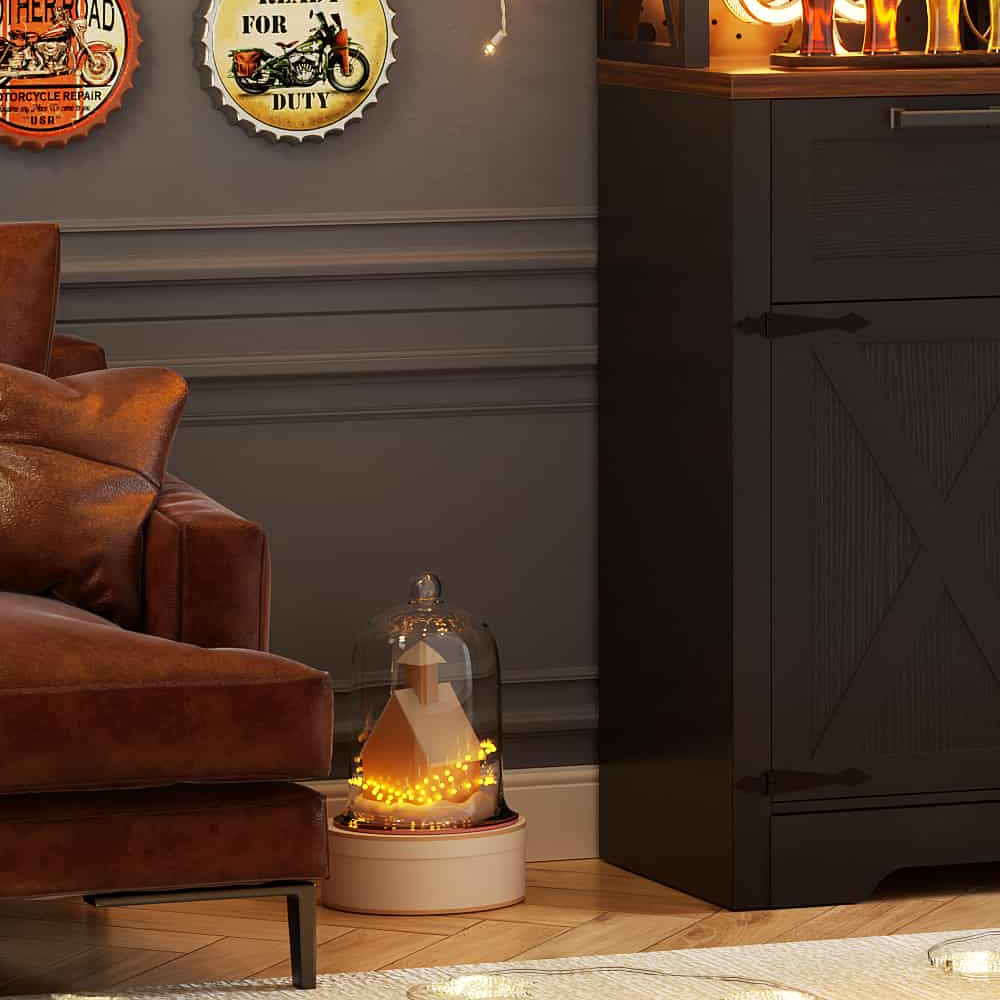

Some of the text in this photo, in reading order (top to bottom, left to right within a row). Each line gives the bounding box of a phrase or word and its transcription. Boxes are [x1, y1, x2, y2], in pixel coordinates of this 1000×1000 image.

[242, 15, 287, 34] FOR
[63, 91, 102, 101] REPAIR
[272, 92, 329, 110] DUTY
